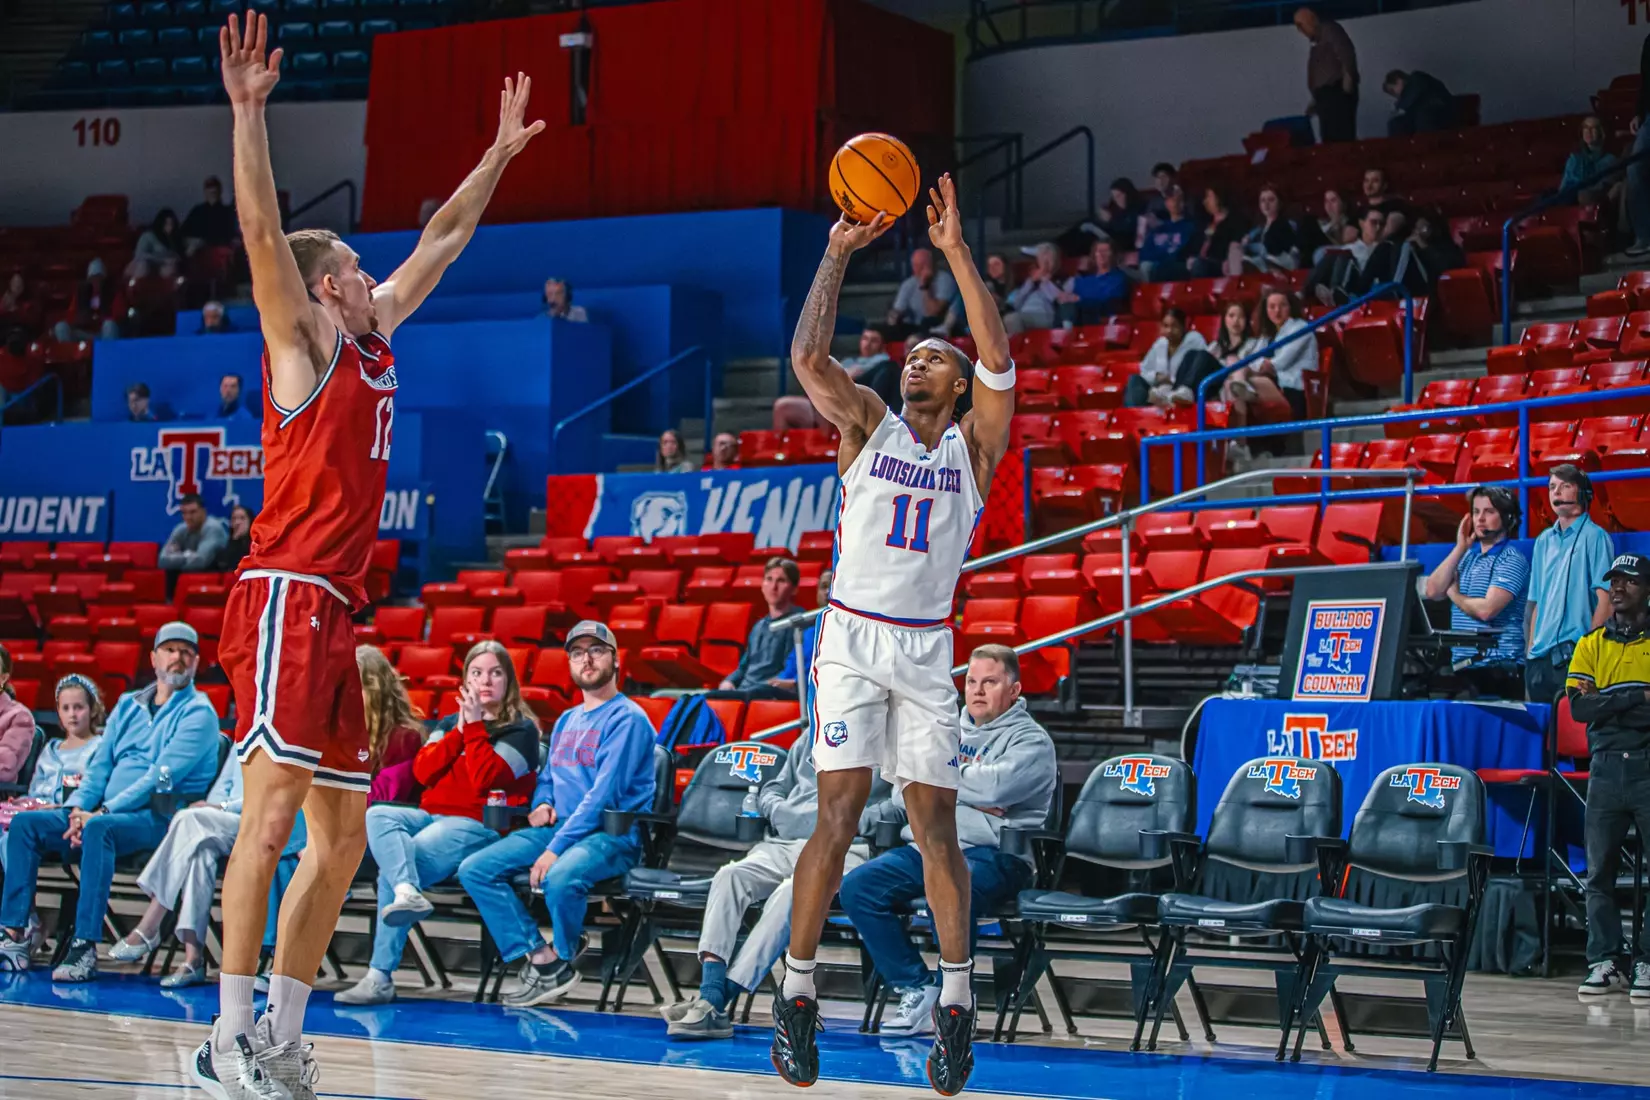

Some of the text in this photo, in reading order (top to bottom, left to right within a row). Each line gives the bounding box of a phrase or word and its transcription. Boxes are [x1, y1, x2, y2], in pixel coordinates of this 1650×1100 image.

[72, 116, 121, 147] 110
[869, 452, 962, 494] LOUISIANA TECH
[885, 493, 935, 554] 11
[1314, 610, 1373, 629] BULLDOG
[1303, 674, 1365, 693] COUNTRY
